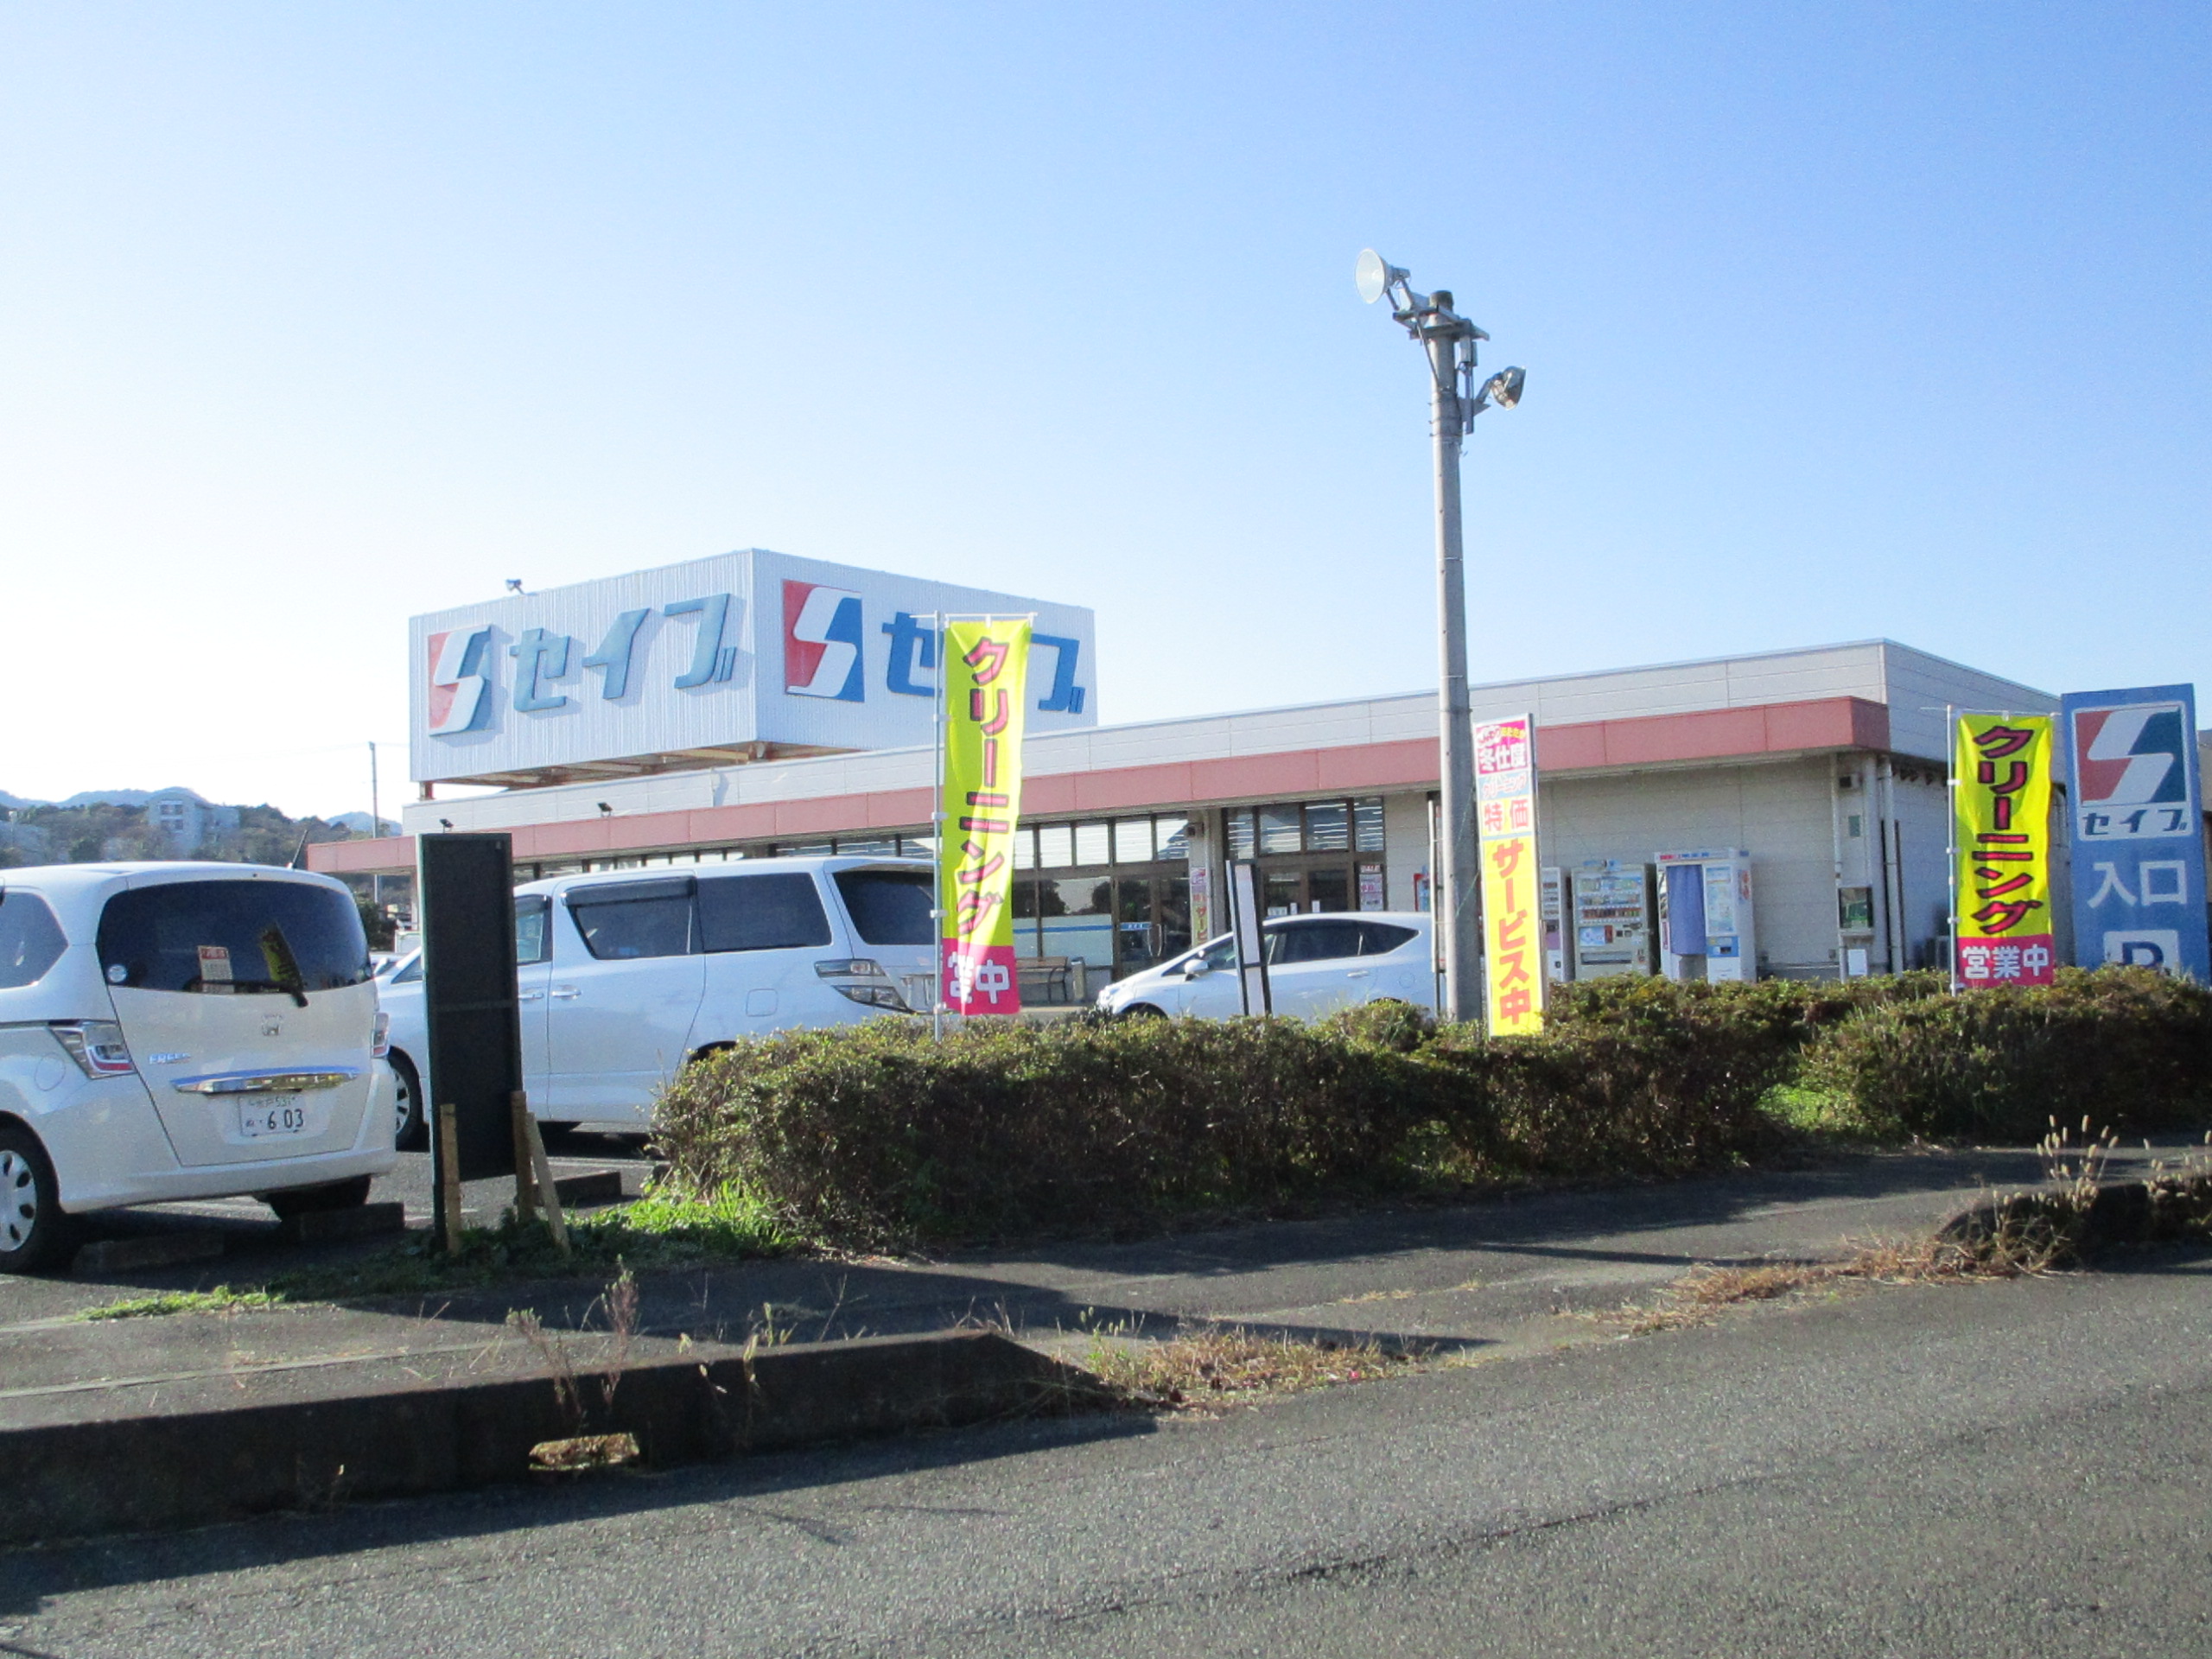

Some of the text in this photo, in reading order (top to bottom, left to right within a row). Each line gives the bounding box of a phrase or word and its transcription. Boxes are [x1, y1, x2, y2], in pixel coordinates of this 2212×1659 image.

[508, 593, 737, 714] セイブ
[882, 612, 1085, 715] セブ
[956, 636, 1010, 937] クリーニング
[1484, 798, 1529, 831] 特価
[2082, 809, 2187, 836] セイブ
[1972, 725, 2044, 935] クリーニング
[2087, 860, 2188, 908] 入口
[1492, 838, 1533, 1026] サービス中
[1961, 944, 2050, 980] 営業中
[947, 951, 1011, 1004] 営中
